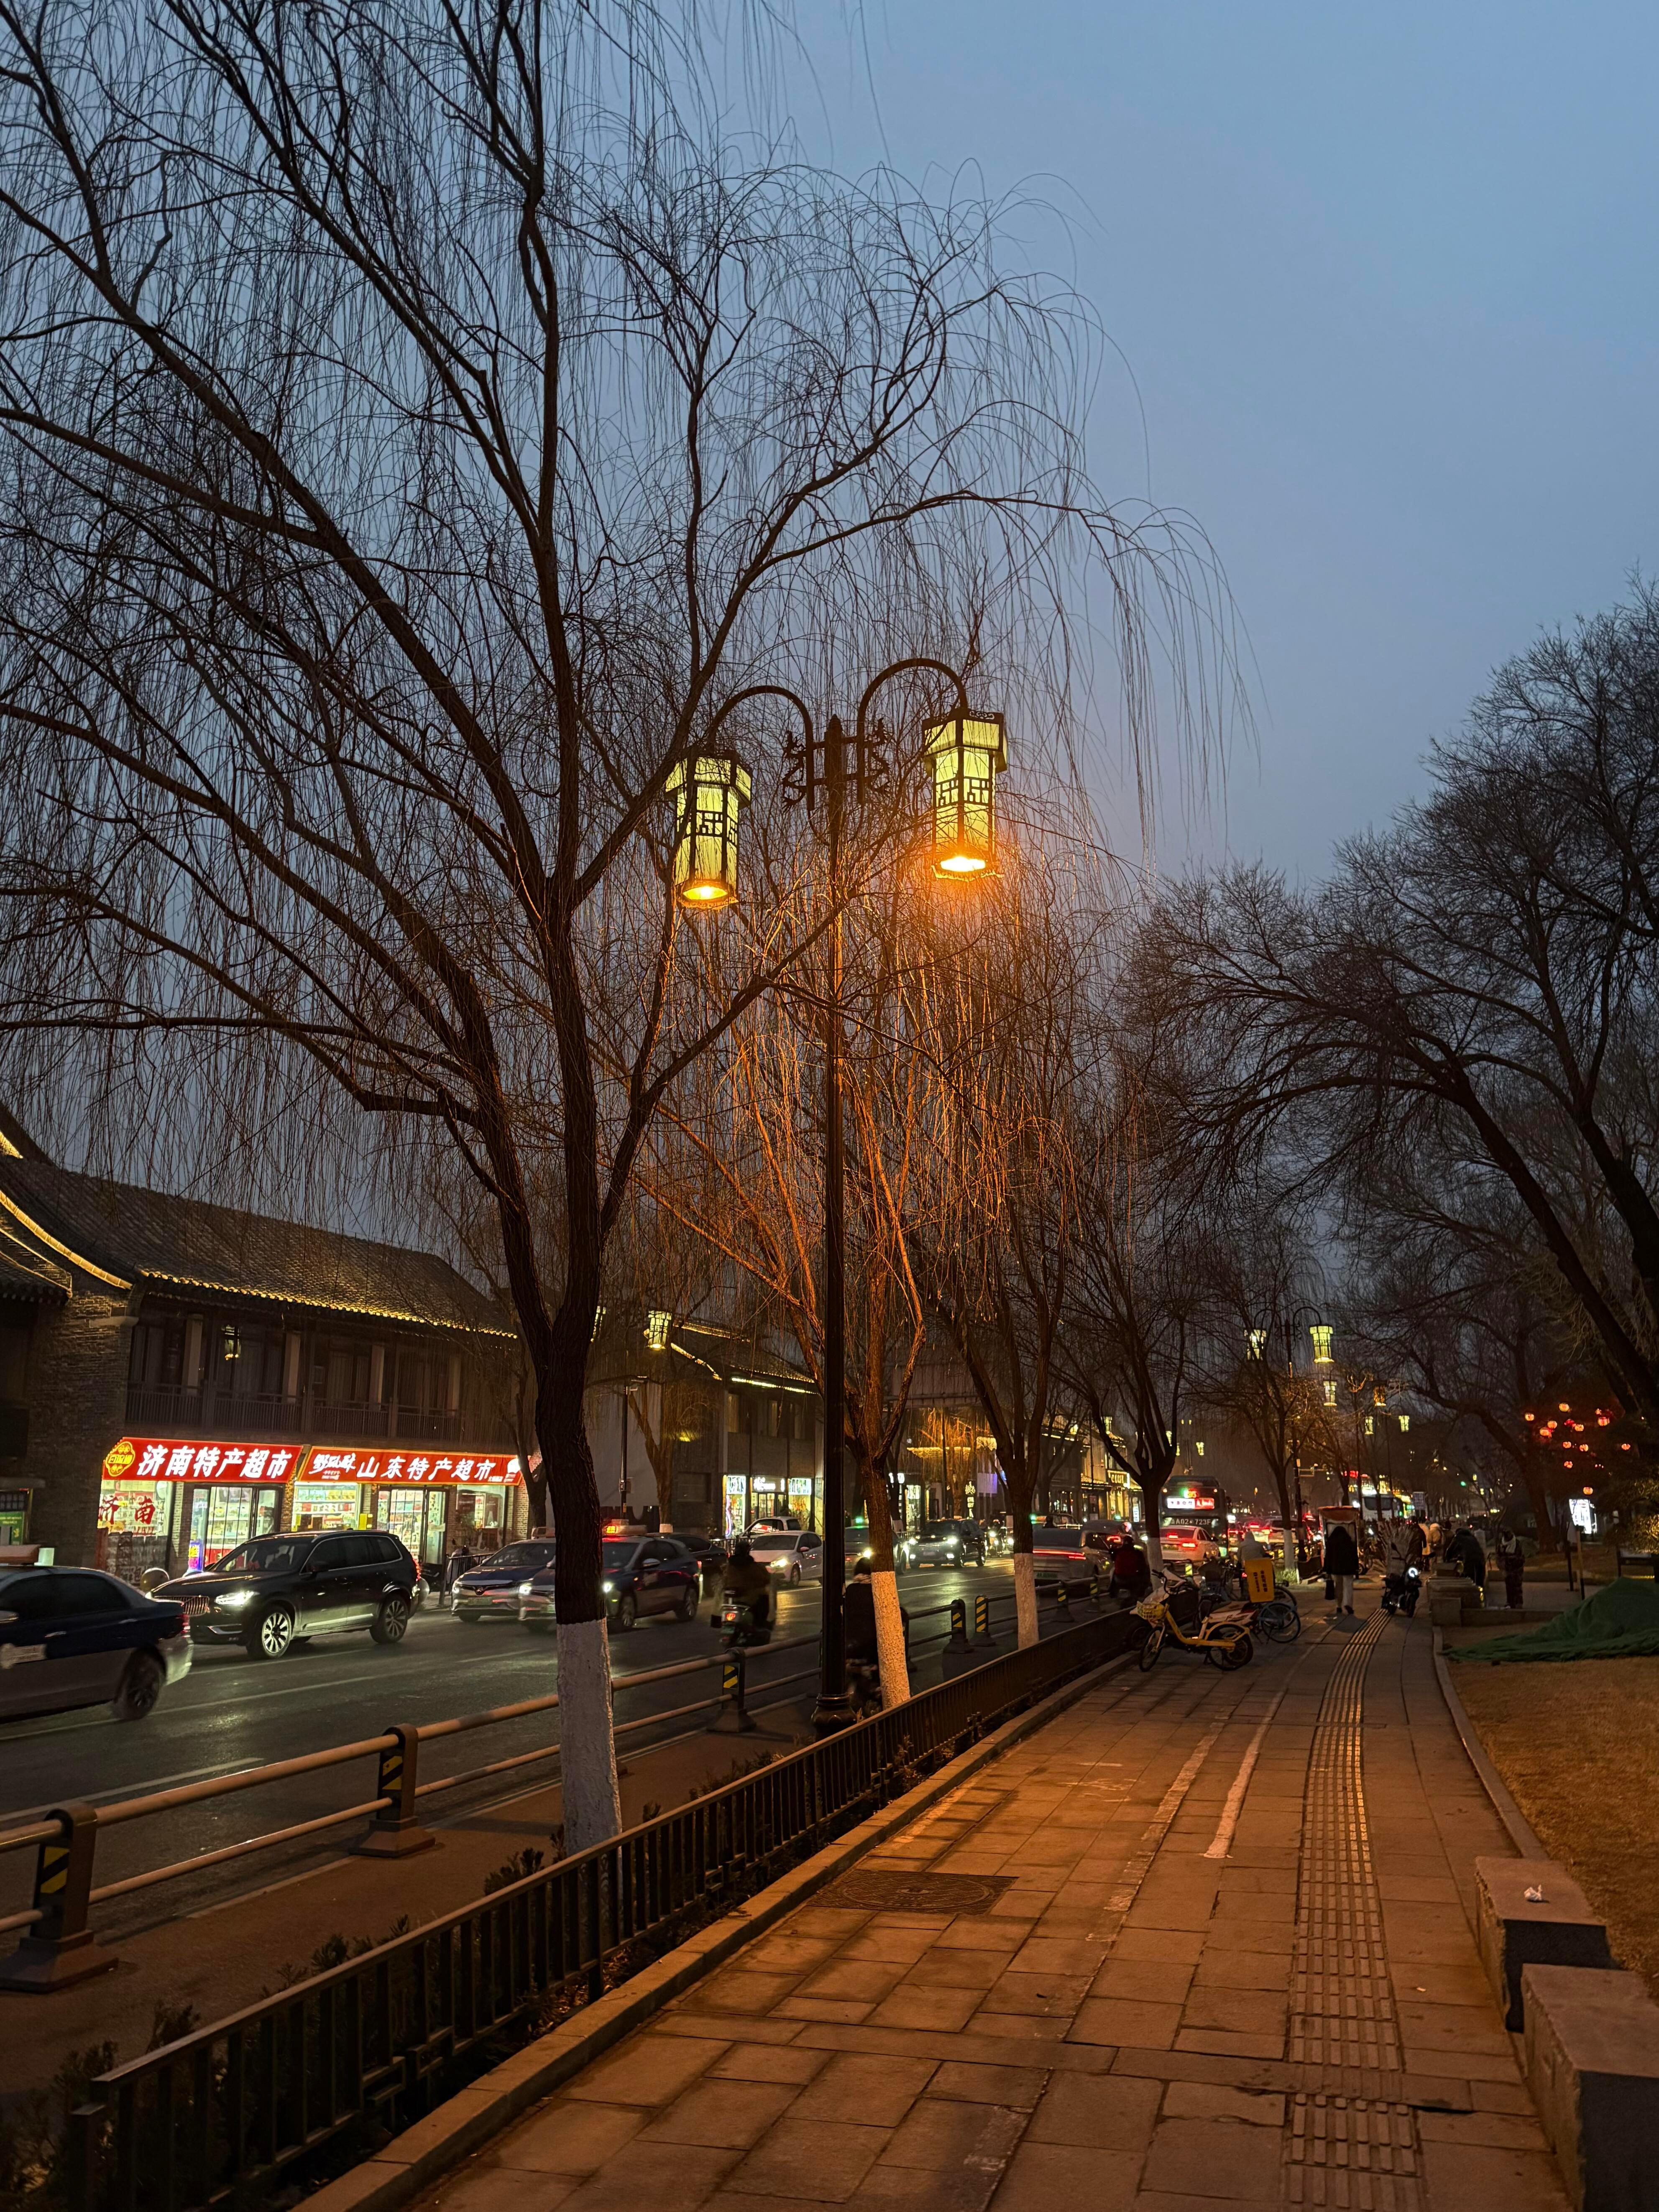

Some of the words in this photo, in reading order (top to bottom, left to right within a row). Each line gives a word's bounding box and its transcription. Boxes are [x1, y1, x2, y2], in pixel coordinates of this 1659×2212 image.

[137, 1445, 292, 1479] 济南特产超市
[356, 1456, 496, 1481] 山东特产超市
